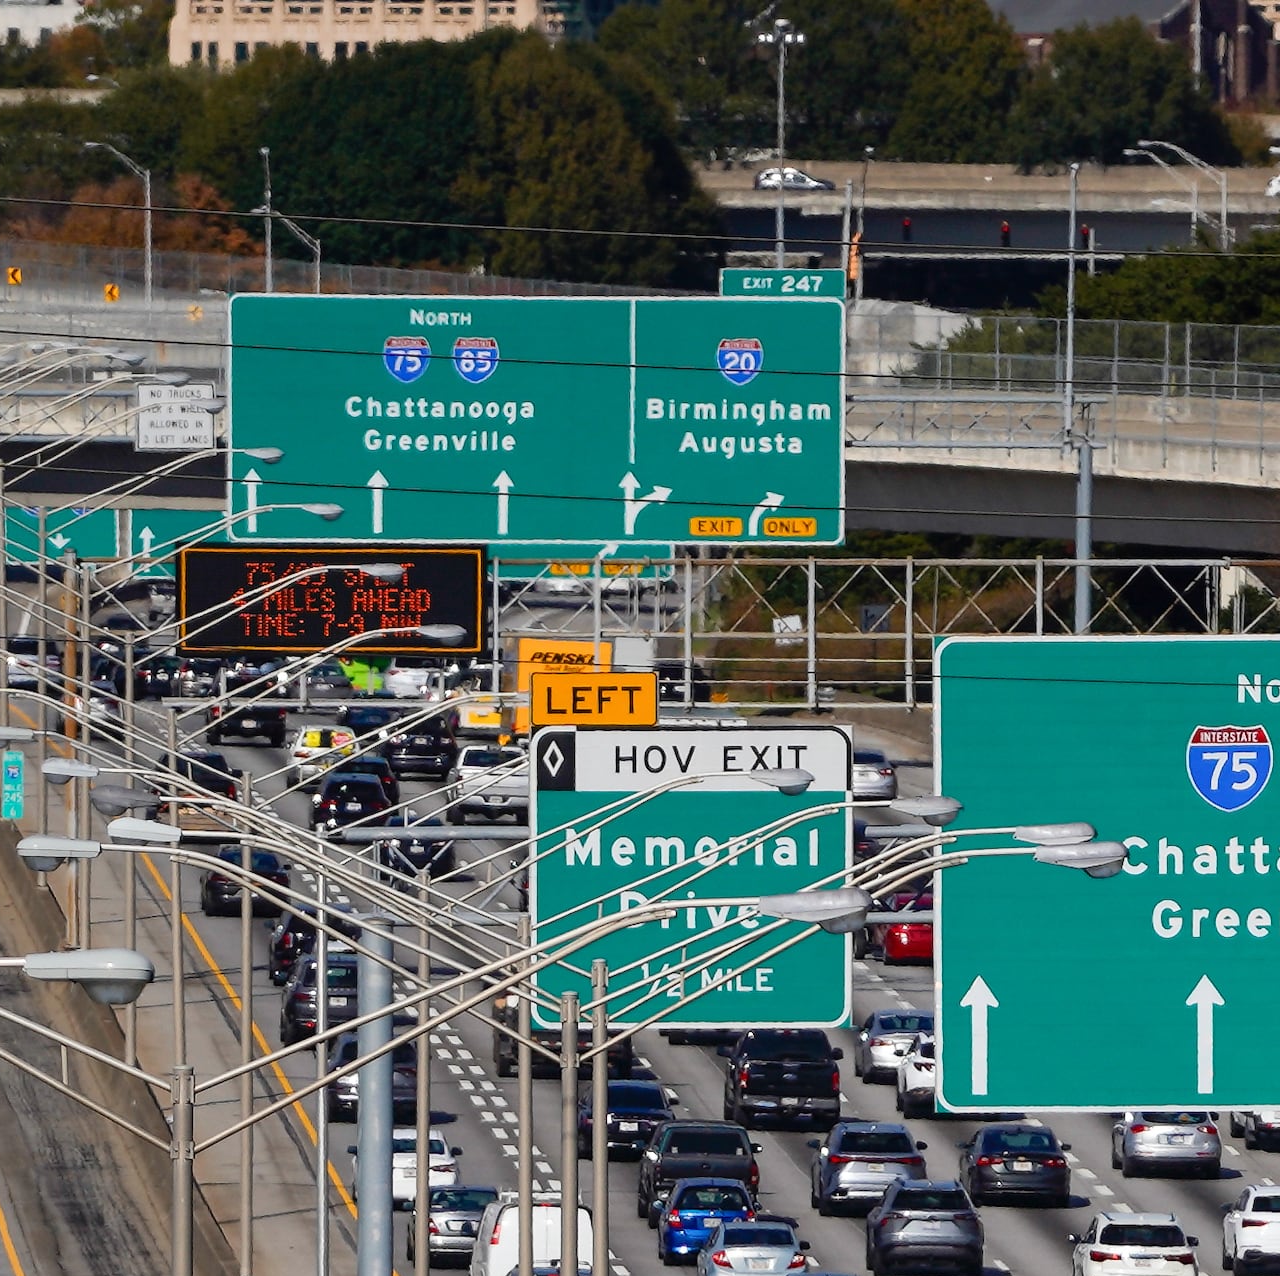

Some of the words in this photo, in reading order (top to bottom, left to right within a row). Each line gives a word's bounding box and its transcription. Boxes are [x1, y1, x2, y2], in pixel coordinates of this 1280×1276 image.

[742, 277, 773, 289] EXIT
[781, 275, 823, 293] 247
[410, 309, 472, 326] NORTH
[390, 350, 422, 373] 75
[460, 350, 492, 373] 85
[724, 351, 756, 375] 20
[150, 390, 162, 399] NO
[168, 390, 202, 399] TRUCKS
[345, 395, 535, 423] Chattanooga
[646, 398, 832, 427] Birmingham
[364, 429, 516, 451] Greenville
[678, 431, 803, 459] Augusta
[697, 519, 735, 534] EXIT
[766, 518, 813, 534] ONLY
[344, 562, 416, 587] SPT
[263, 587, 336, 612] MILES
[351, 588, 432, 612] AHEAD
[239, 612, 306, 638] TIME:
[320, 612, 366, 638] 7-9
[380, 613, 422, 638] MIN
[546, 686, 643, 715] LEFT
[1199, 731, 1259, 743] INTERSTATE
[614, 745, 697, 774] HOV
[723, 744, 809, 772] EXIT
[1202, 751, 1258, 791] 75
[564, 827, 820, 868] Memorial
[700, 967, 774, 993] MILE
